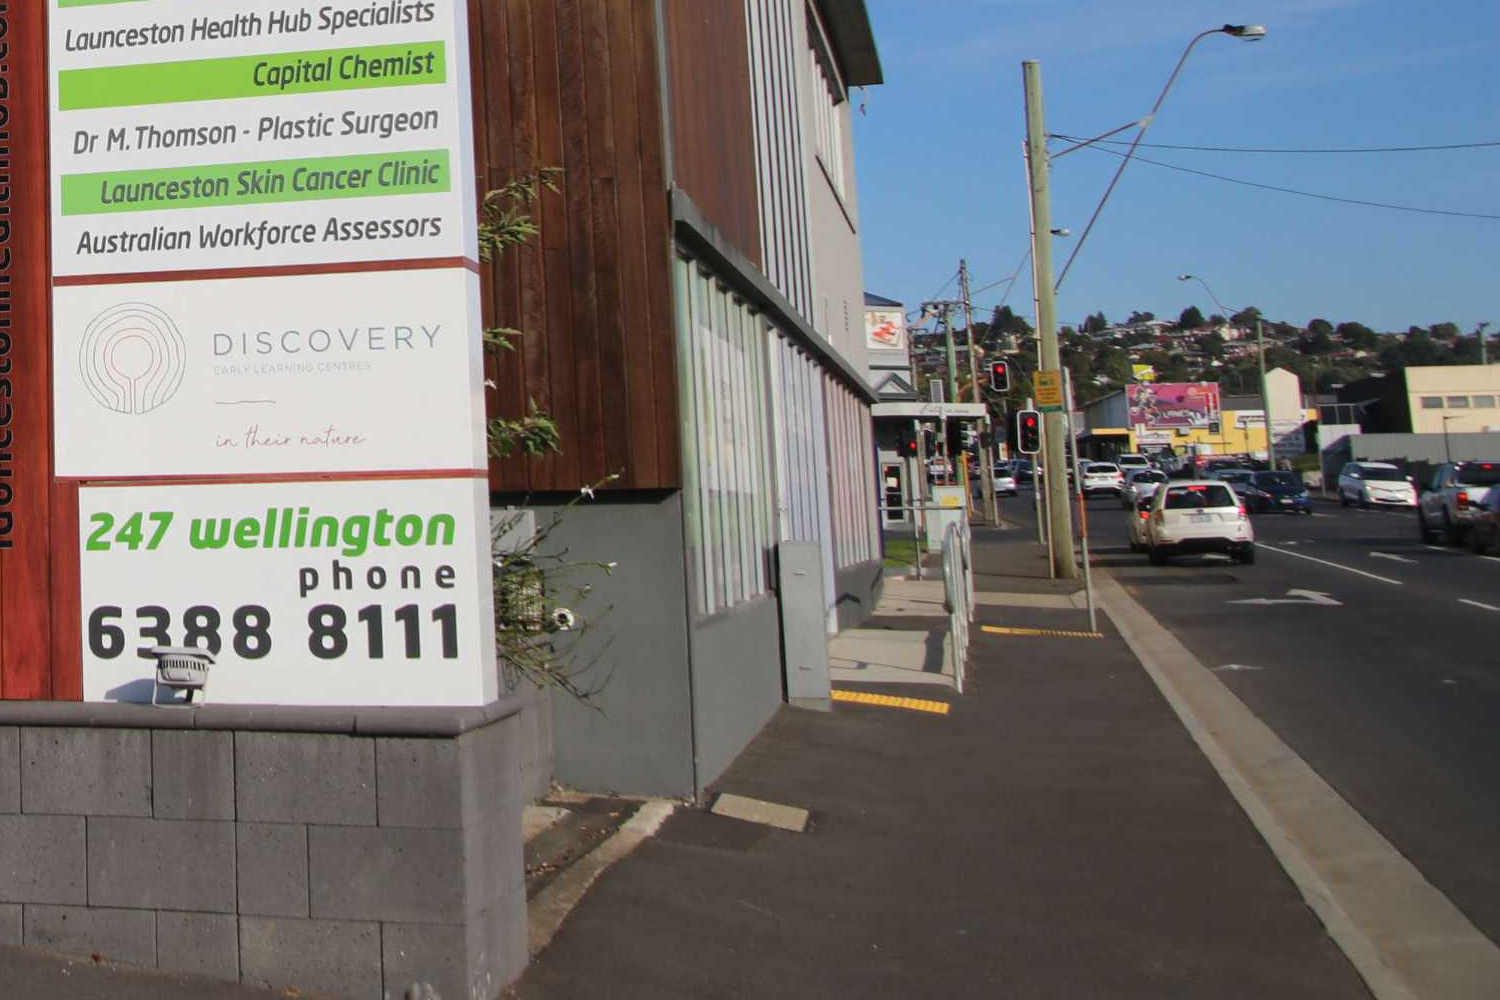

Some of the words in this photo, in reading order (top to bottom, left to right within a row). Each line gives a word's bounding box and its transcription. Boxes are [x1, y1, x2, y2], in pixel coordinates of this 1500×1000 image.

[65, 20, 184, 52] Launceston
[191, 11, 261, 42] Health
[268, 7, 311, 34] Hub
[318, 0, 435, 35] Specialists
[254, 58, 331, 90] Capital
[339, 51, 435, 79] Chemist
[73, 130, 98, 154] Dr
[258, 113, 334, 141] Plastic
[340, 108, 439, 139] Surgeon
[101, 176, 229, 204] Launceston
[237, 169, 284, 196] Skin
[292, 166, 372, 192] Cancer
[378, 159, 440, 187] Clinic
[77, 226, 191, 255] Australian
[199, 220, 316, 250] Workforce
[323, 215, 441, 242] Assessors
[213, 324, 441, 356] DISCOVERY
[213, 365, 251, 376] EARLY
[254, 362, 313, 375] LEARNING
[318, 361, 372, 372] CENTRES
[215, 433, 238, 447] in
[244, 424, 291, 448] their
[300, 424, 364, 445] nature
[86, 511, 174, 551] 247
[189, 507, 455, 557] wellington
[299, 560, 455, 597] phone
[88, 604, 272, 660] 6388
[307, 603, 458, 660] 8111
